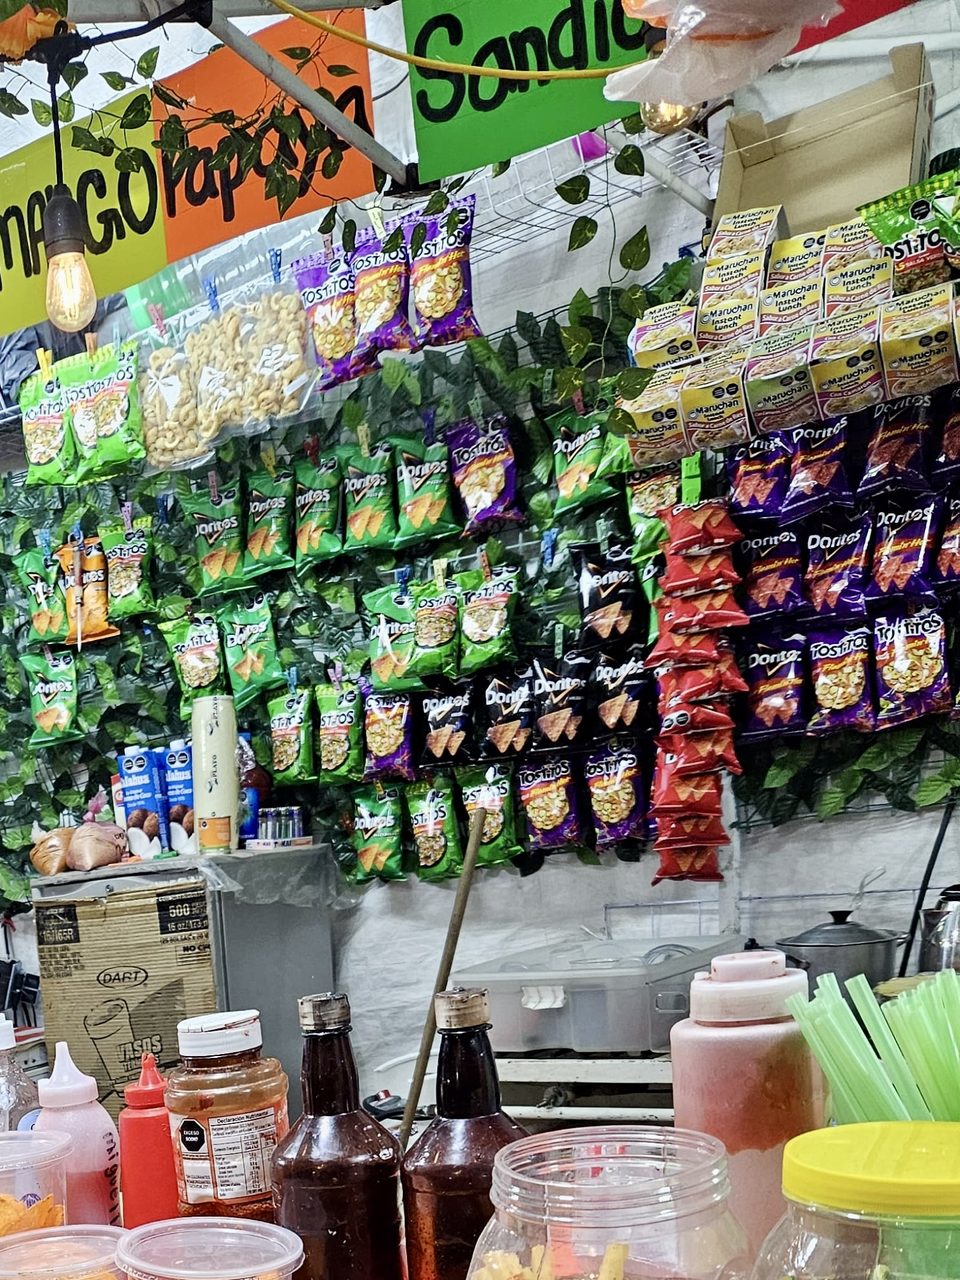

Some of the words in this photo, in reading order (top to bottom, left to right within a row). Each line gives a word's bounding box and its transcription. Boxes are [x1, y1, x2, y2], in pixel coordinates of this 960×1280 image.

[839, 262, 888, 279] Maruchan
[841, 273, 876, 286] Instant
[772, 283, 818, 300] Maruchan
[775, 295, 807, 307] Instant
[709, 303, 753, 318] Maruchan
[711, 314, 742, 326] Instant
[898, 345, 948, 366] Maruchan
[827, 363, 876, 386] Maruchan
[763, 383, 809, 403] Maruchan
[696, 399, 739, 415] Maruchan
[873, 395, 932, 418] Doritos
[552, 424, 601, 454] Doritos
[792, 416, 848, 443] Doritos
[396, 458, 448, 482] Doritos
[877, 508, 932, 528] Doritos
[741, 532, 797, 551] Doritos
[807, 529, 862, 549] Doritos
[749, 650, 802, 668] Doritos
[596, 660, 644, 681] Doritos
[534, 677, 586, 696] Doritos
[423, 694, 470, 714] Doritos
[169, 904, 190, 918] 500
[103, 971, 141, 984] DART
